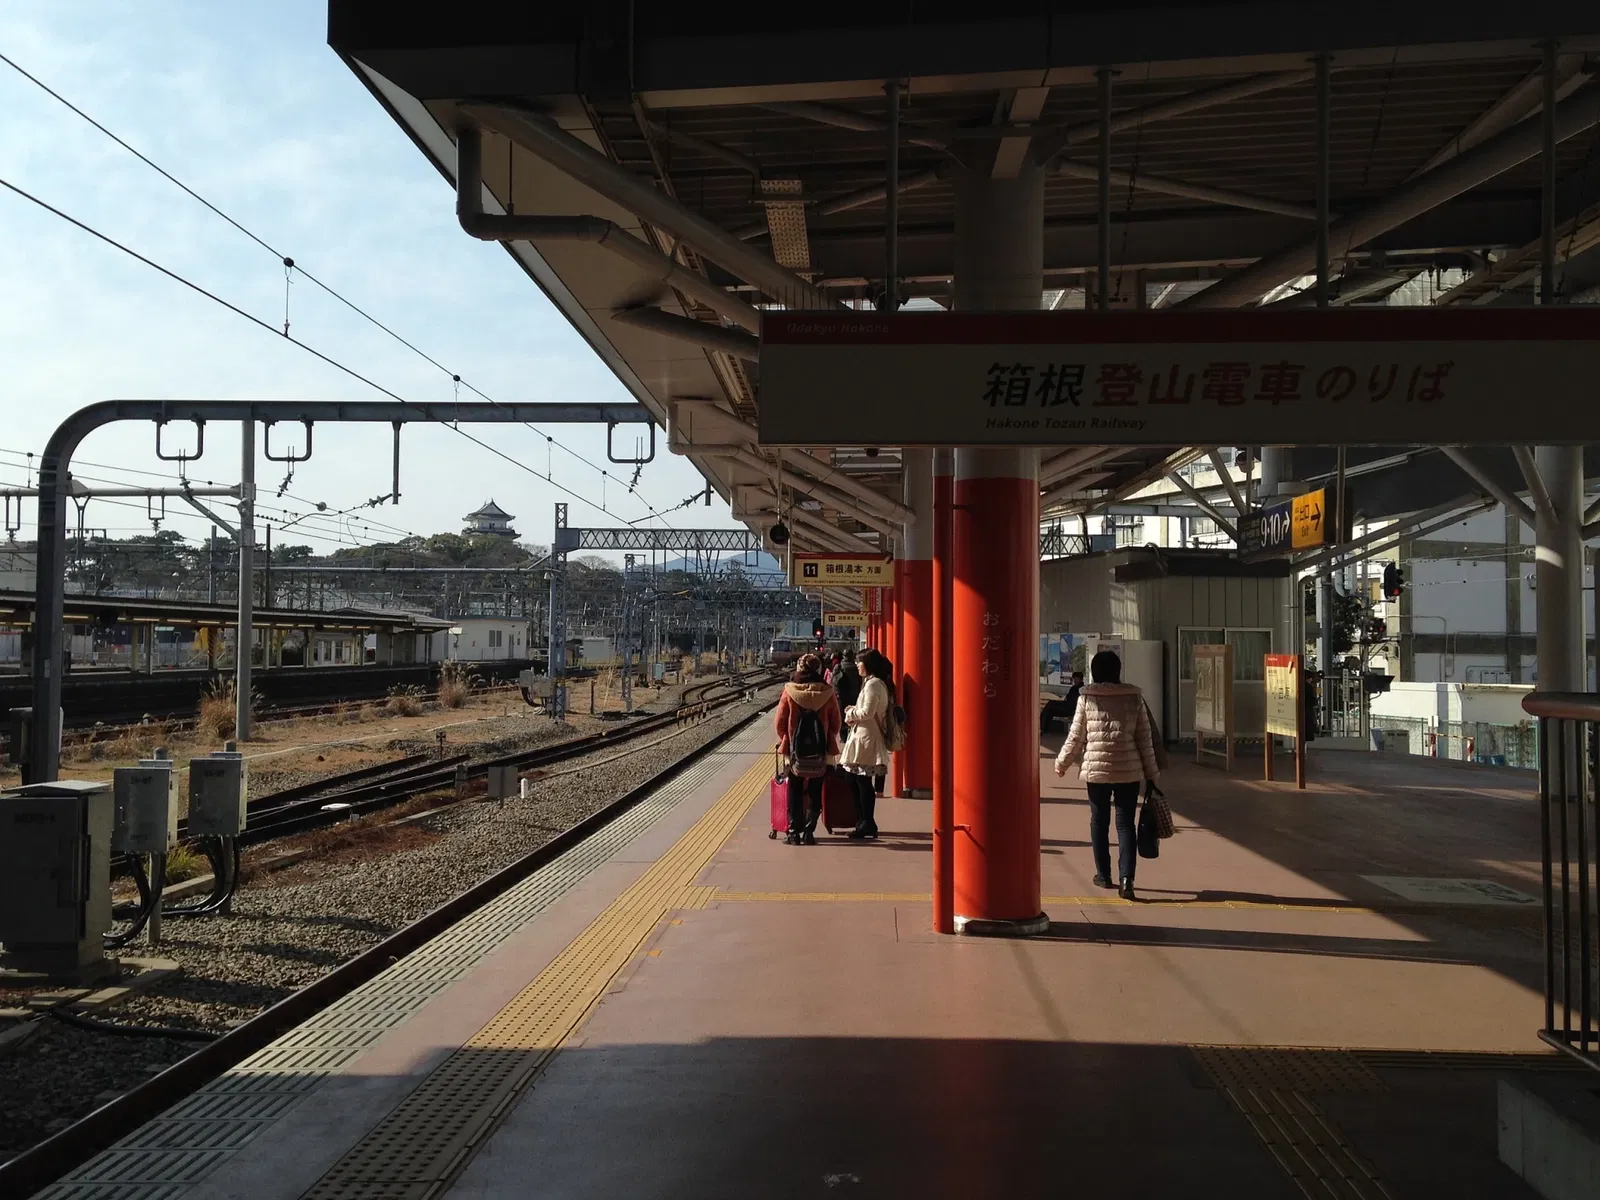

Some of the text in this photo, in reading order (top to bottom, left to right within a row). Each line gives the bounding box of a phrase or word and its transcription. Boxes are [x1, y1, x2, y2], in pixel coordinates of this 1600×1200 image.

[982, 360, 1455, 407] 箱根登山電車のりば
[985, 417, 1147, 431] Hakone Tozan Railway
[804, 565, 817, 575] 11
[826, 564, 863, 574] 箱根湯本
[981, 611, 1001, 698] おだわら
